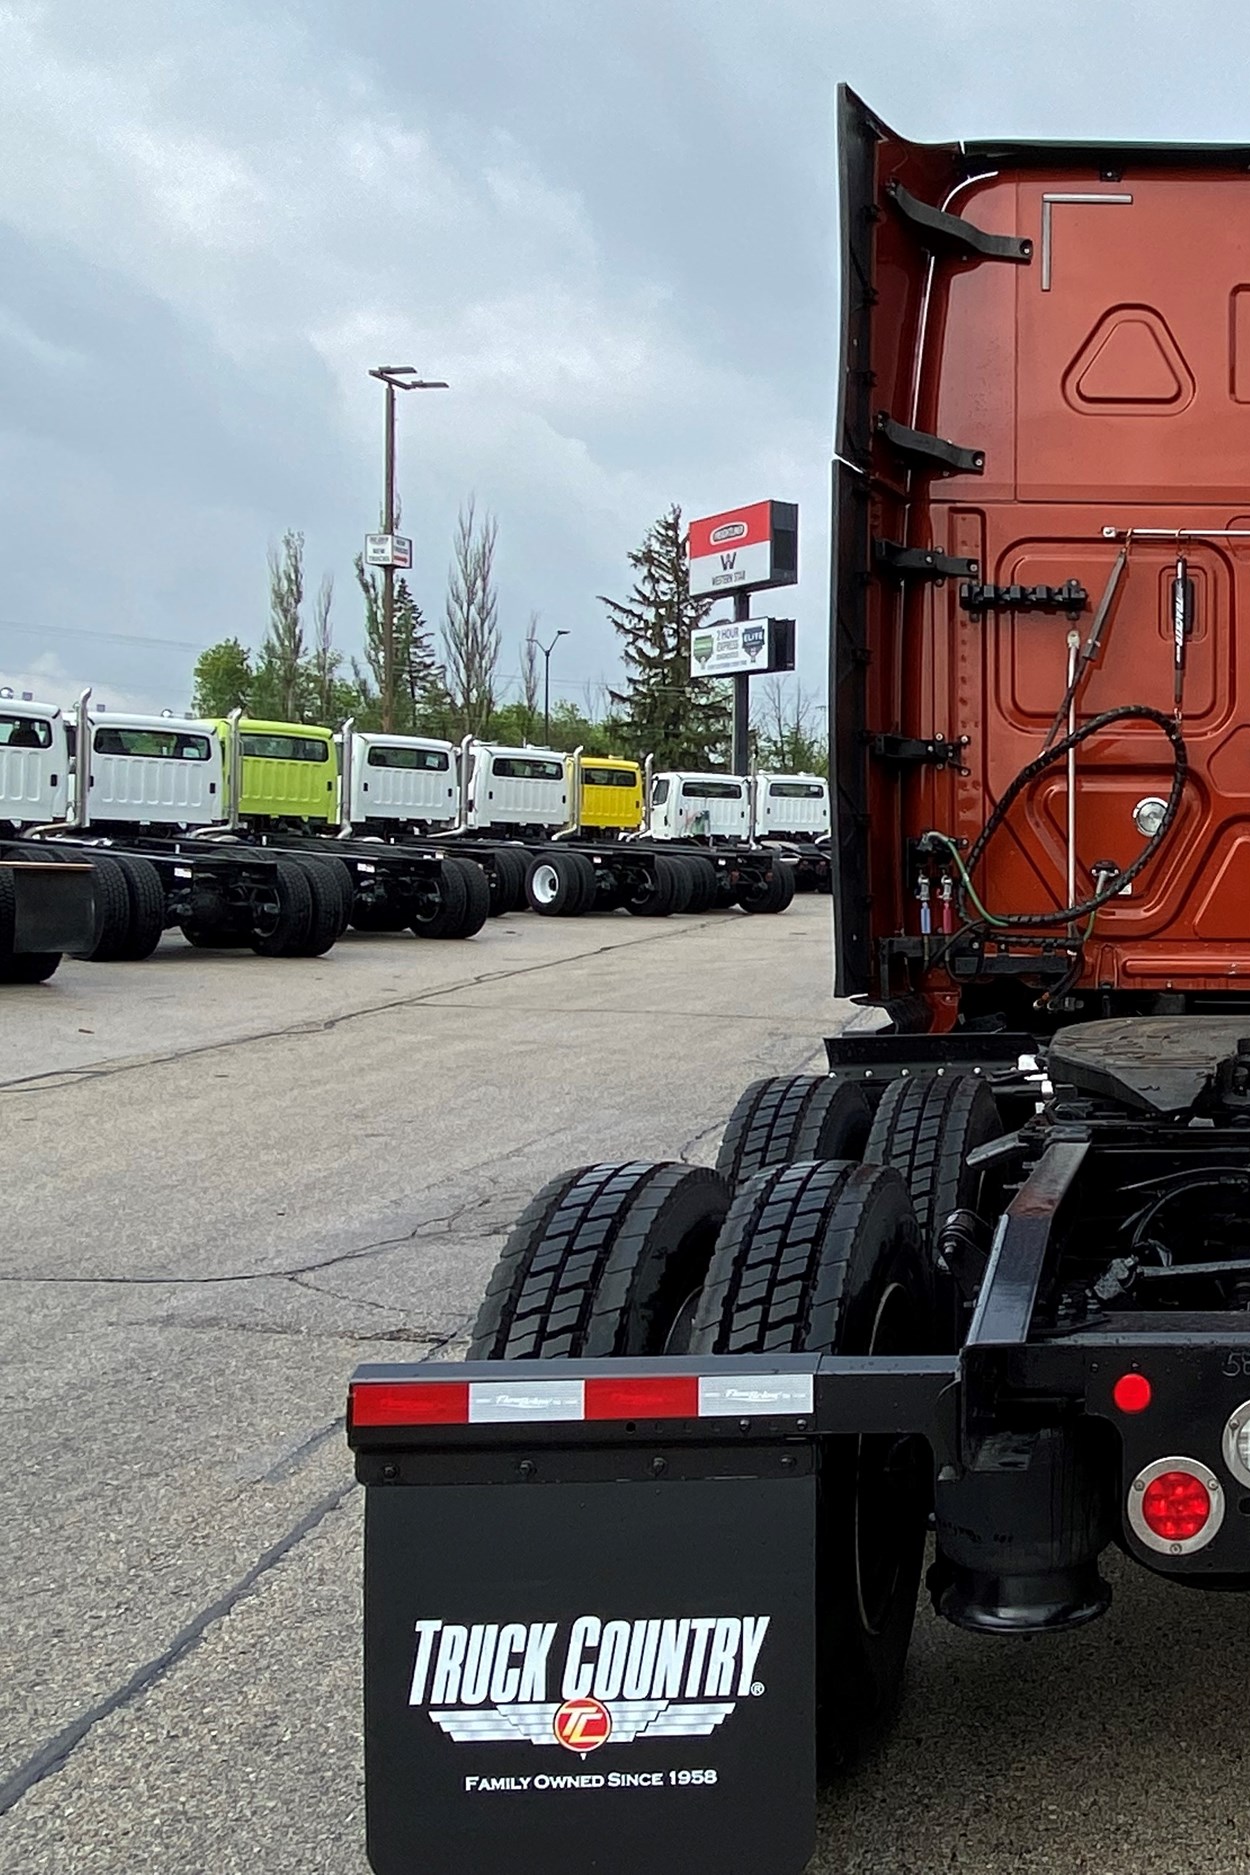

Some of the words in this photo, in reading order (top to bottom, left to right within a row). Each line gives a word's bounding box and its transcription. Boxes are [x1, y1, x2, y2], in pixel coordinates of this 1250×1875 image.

[409, 1618, 558, 1706] TRUCK
[464, 1774, 530, 1792] FAMILY
[533, 1773, 606, 1790] OWNED
[606, 1771, 664, 1788] SINCE
[668, 1769, 718, 1786] 1958
